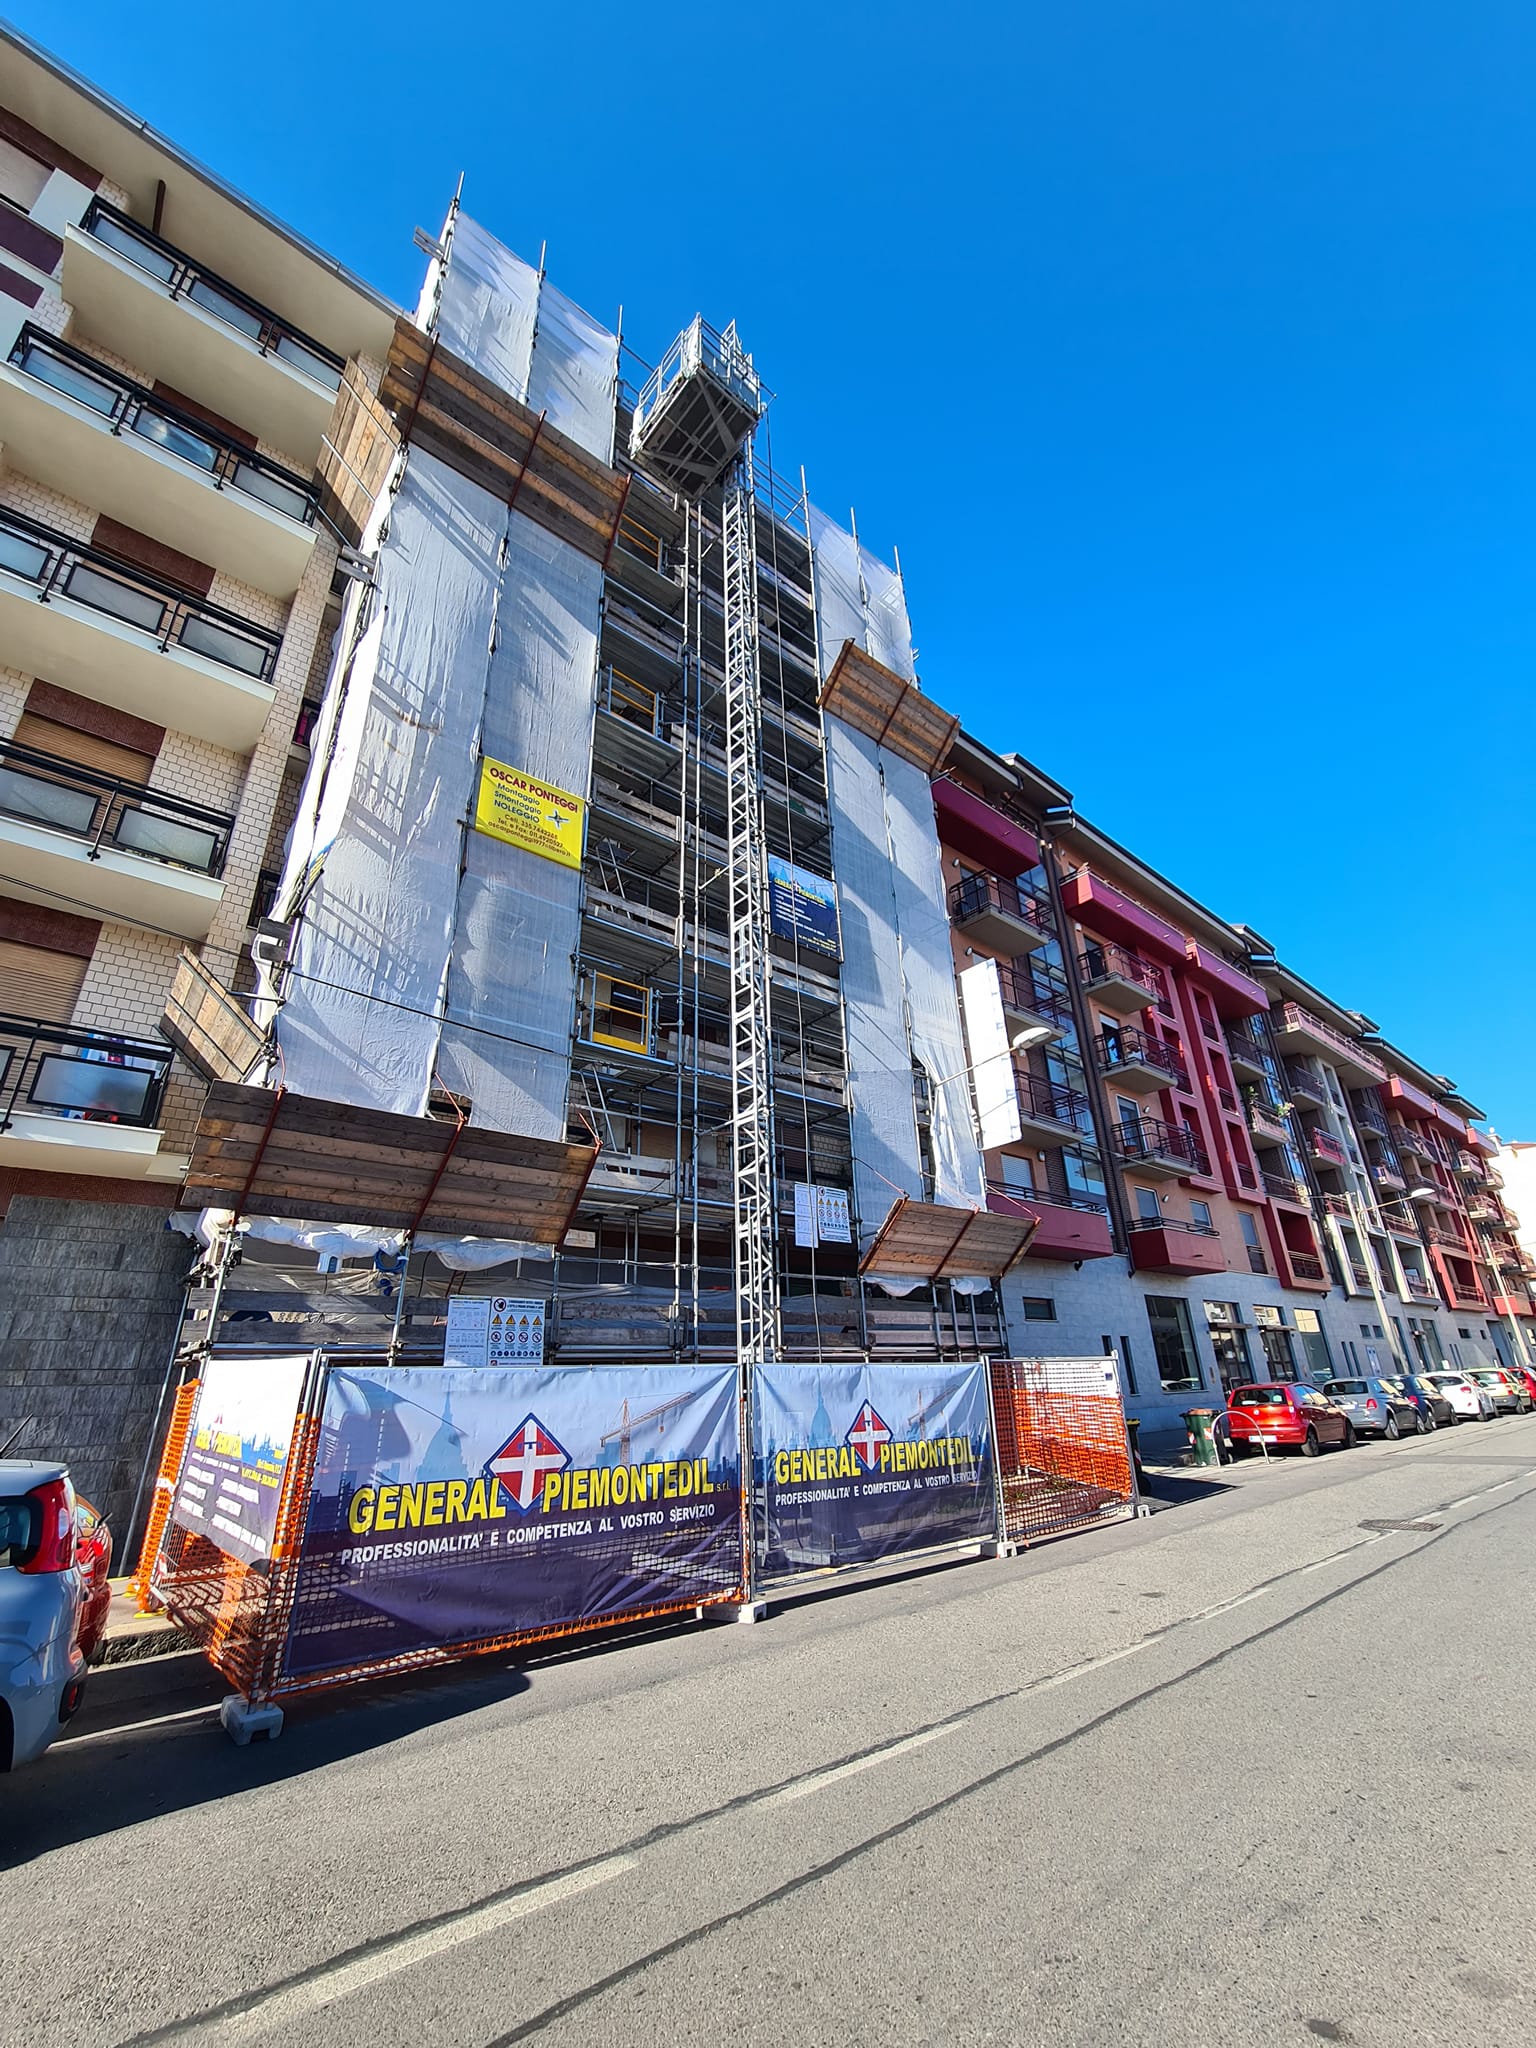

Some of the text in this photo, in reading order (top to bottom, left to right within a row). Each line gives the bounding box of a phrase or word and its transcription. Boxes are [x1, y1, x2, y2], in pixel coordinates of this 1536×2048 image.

[490, 767, 578, 813] OSCAR PONTEGGI
[494, 790, 542, 815] Smontaggio
[497, 783, 540, 806] Montaggio
[494, 800, 540, 823] NOLEGGIO
[775, 1436, 976, 1485] GENERAL PIEMONTEDIL
[348, 1477, 507, 1535] GENERAL
[541, 1457, 715, 1513] PIEMONTEDIL
[854, 1484, 860, 1497] E
[862, 1480, 911, 1496] COMPETENZA
[913, 1478, 923, 1489] AL
[925, 1474, 951, 1487] VOSTRO
[952, 1470, 978, 1484] SERVIZIO
[507, 1520, 593, 1545] COMPETENZA
[598, 1518, 614, 1533] AL
[620, 1512, 664, 1530] VOSTRO
[669, 1503, 716, 1523] SERVIZIO
